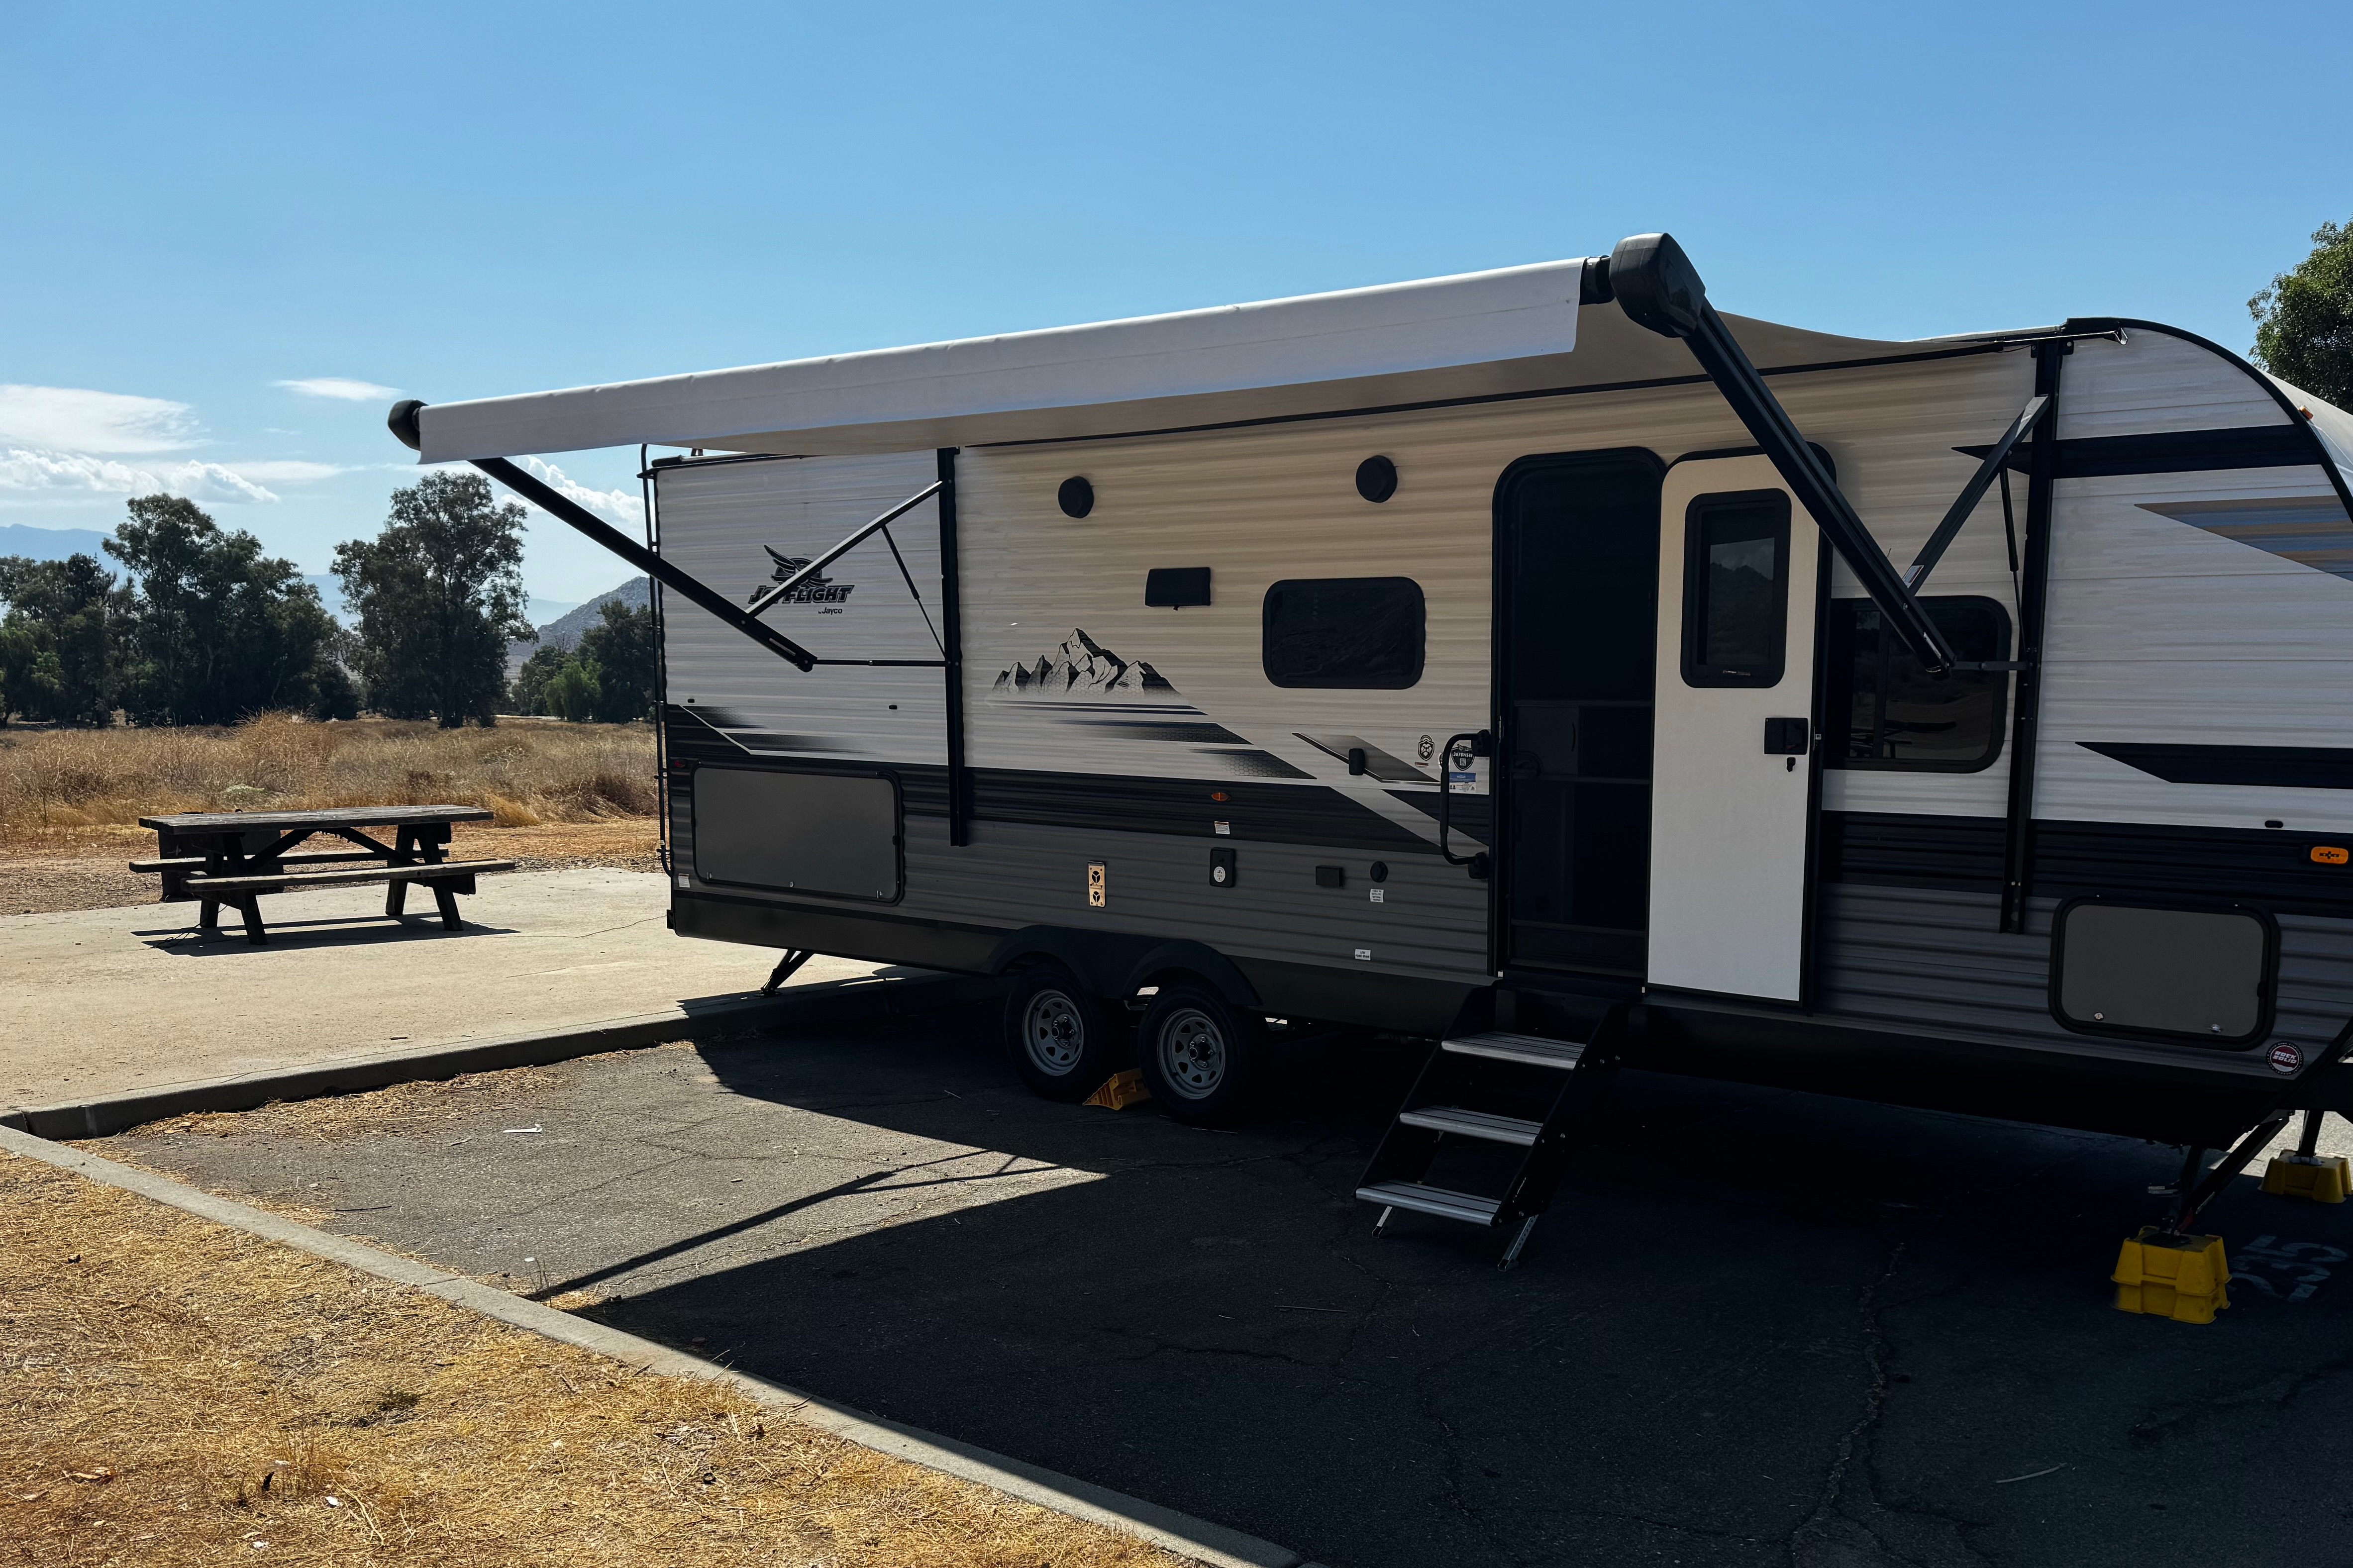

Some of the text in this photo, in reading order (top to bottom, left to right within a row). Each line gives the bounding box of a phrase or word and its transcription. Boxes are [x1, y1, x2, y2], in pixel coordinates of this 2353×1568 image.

[782, 585, 855, 603] FLIGHT
[822, 606, 842, 615] Jayco
[2272, 1055, 2297, 1064] SOLID
[2274, 1051, 2297, 1059] ROCK
